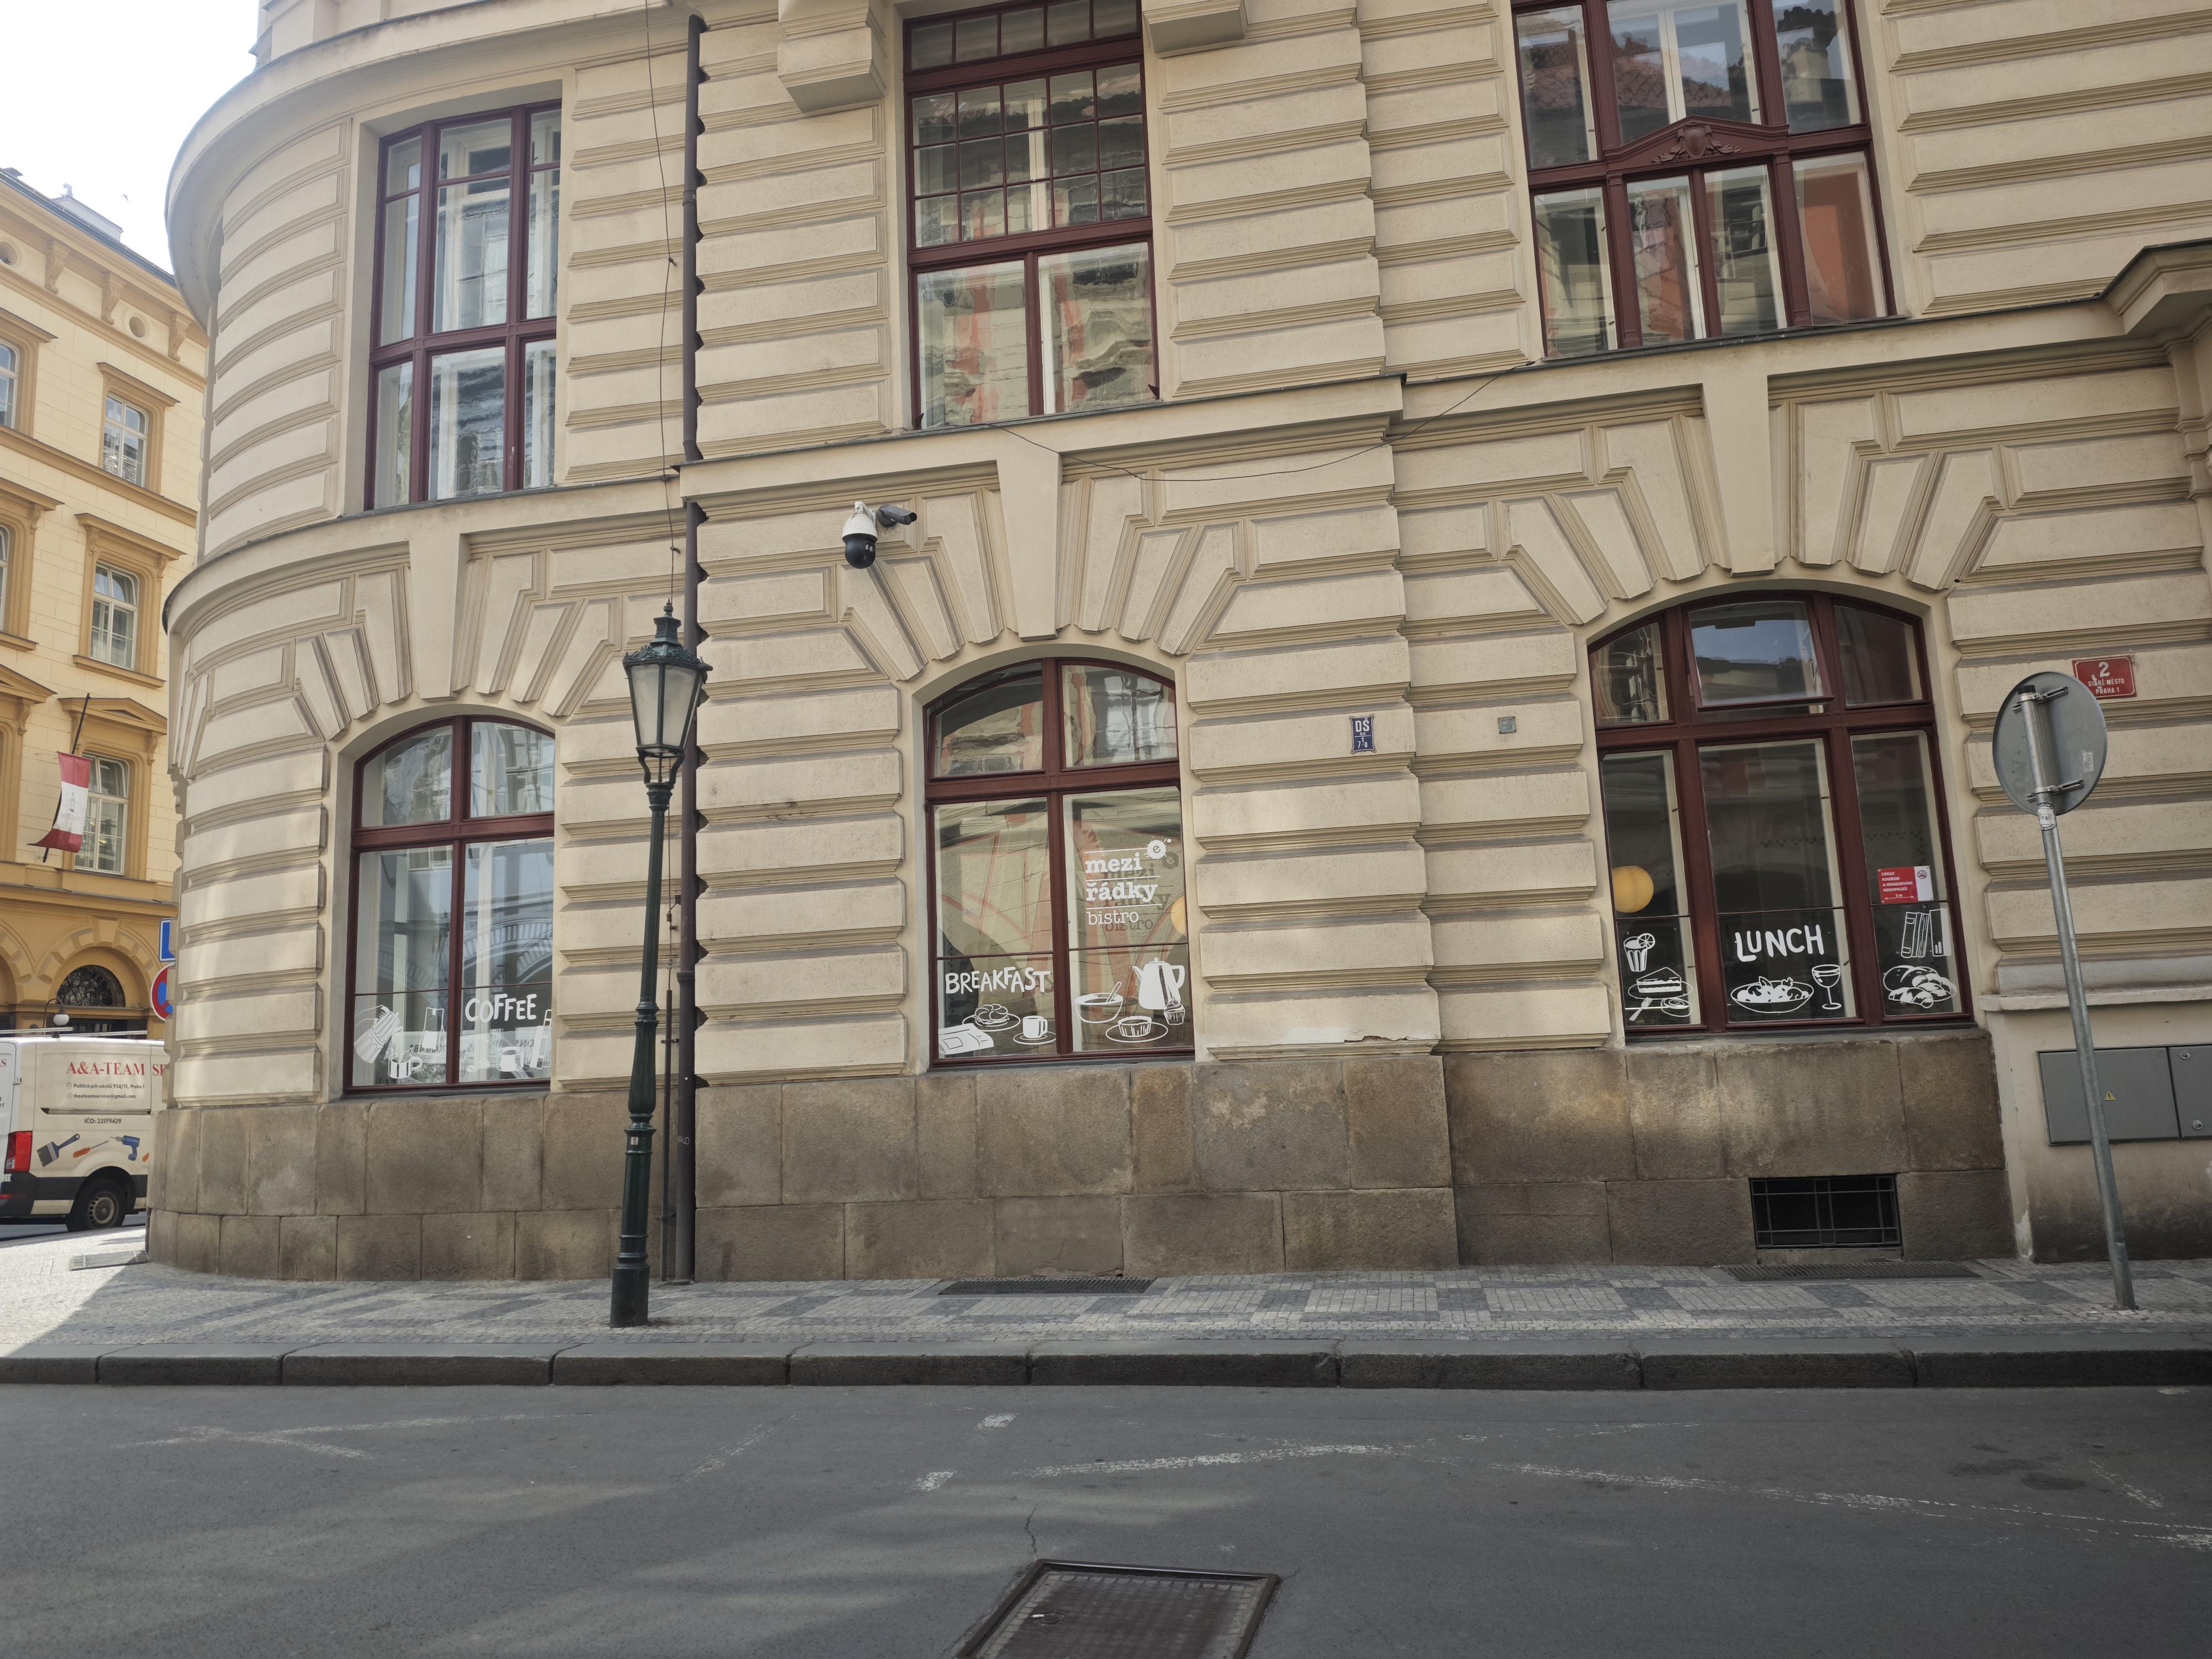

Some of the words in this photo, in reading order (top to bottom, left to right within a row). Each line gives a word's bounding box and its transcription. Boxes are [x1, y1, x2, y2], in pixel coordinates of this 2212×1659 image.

[2099, 662, 2110, 677] 2
[2088, 678, 2105, 686] STARÉ
[1355, 718, 1370, 732] DŠ
[1085, 852, 1142, 874] mezi
[1086, 881, 1158, 902] řádky
[1086, 910, 1139, 925] bistro
[1735, 925, 1824, 962] LUNCH
[945, 967, 1051, 994] BREAKFAST
[465, 993, 537, 1022] COFFEE
[66, 1061, 145, 1076] A&A-TEAM
